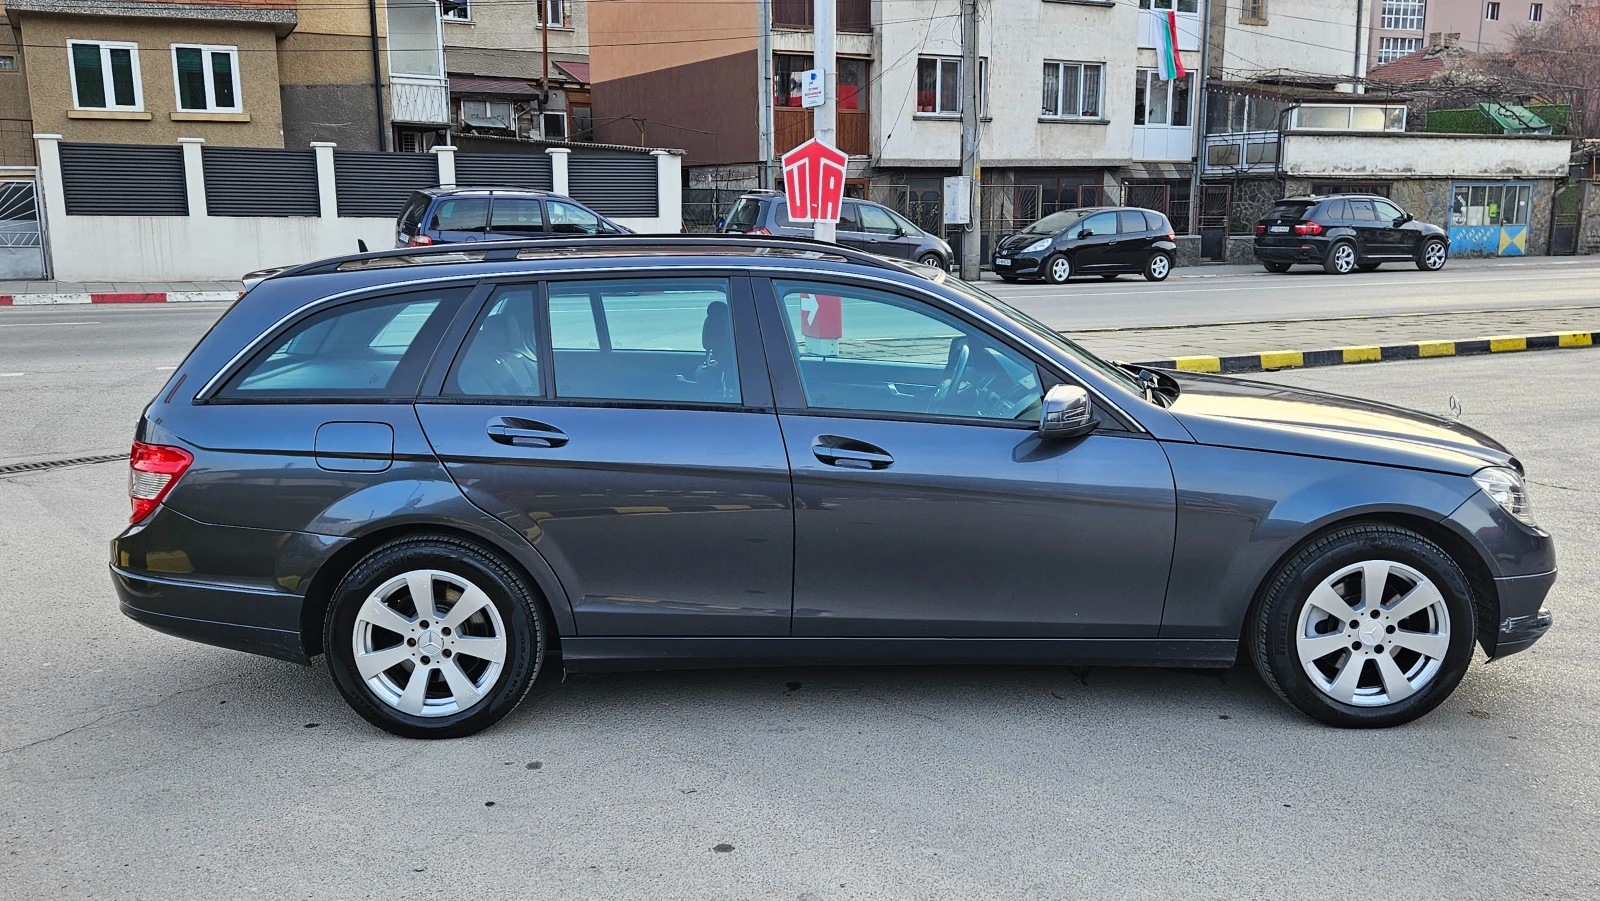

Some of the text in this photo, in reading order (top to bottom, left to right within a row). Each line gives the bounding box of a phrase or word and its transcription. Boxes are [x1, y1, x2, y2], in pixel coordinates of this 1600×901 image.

[1275, 613, 1288, 655] PIRELLI
[503, 628, 526, 700] 205/55 R16
